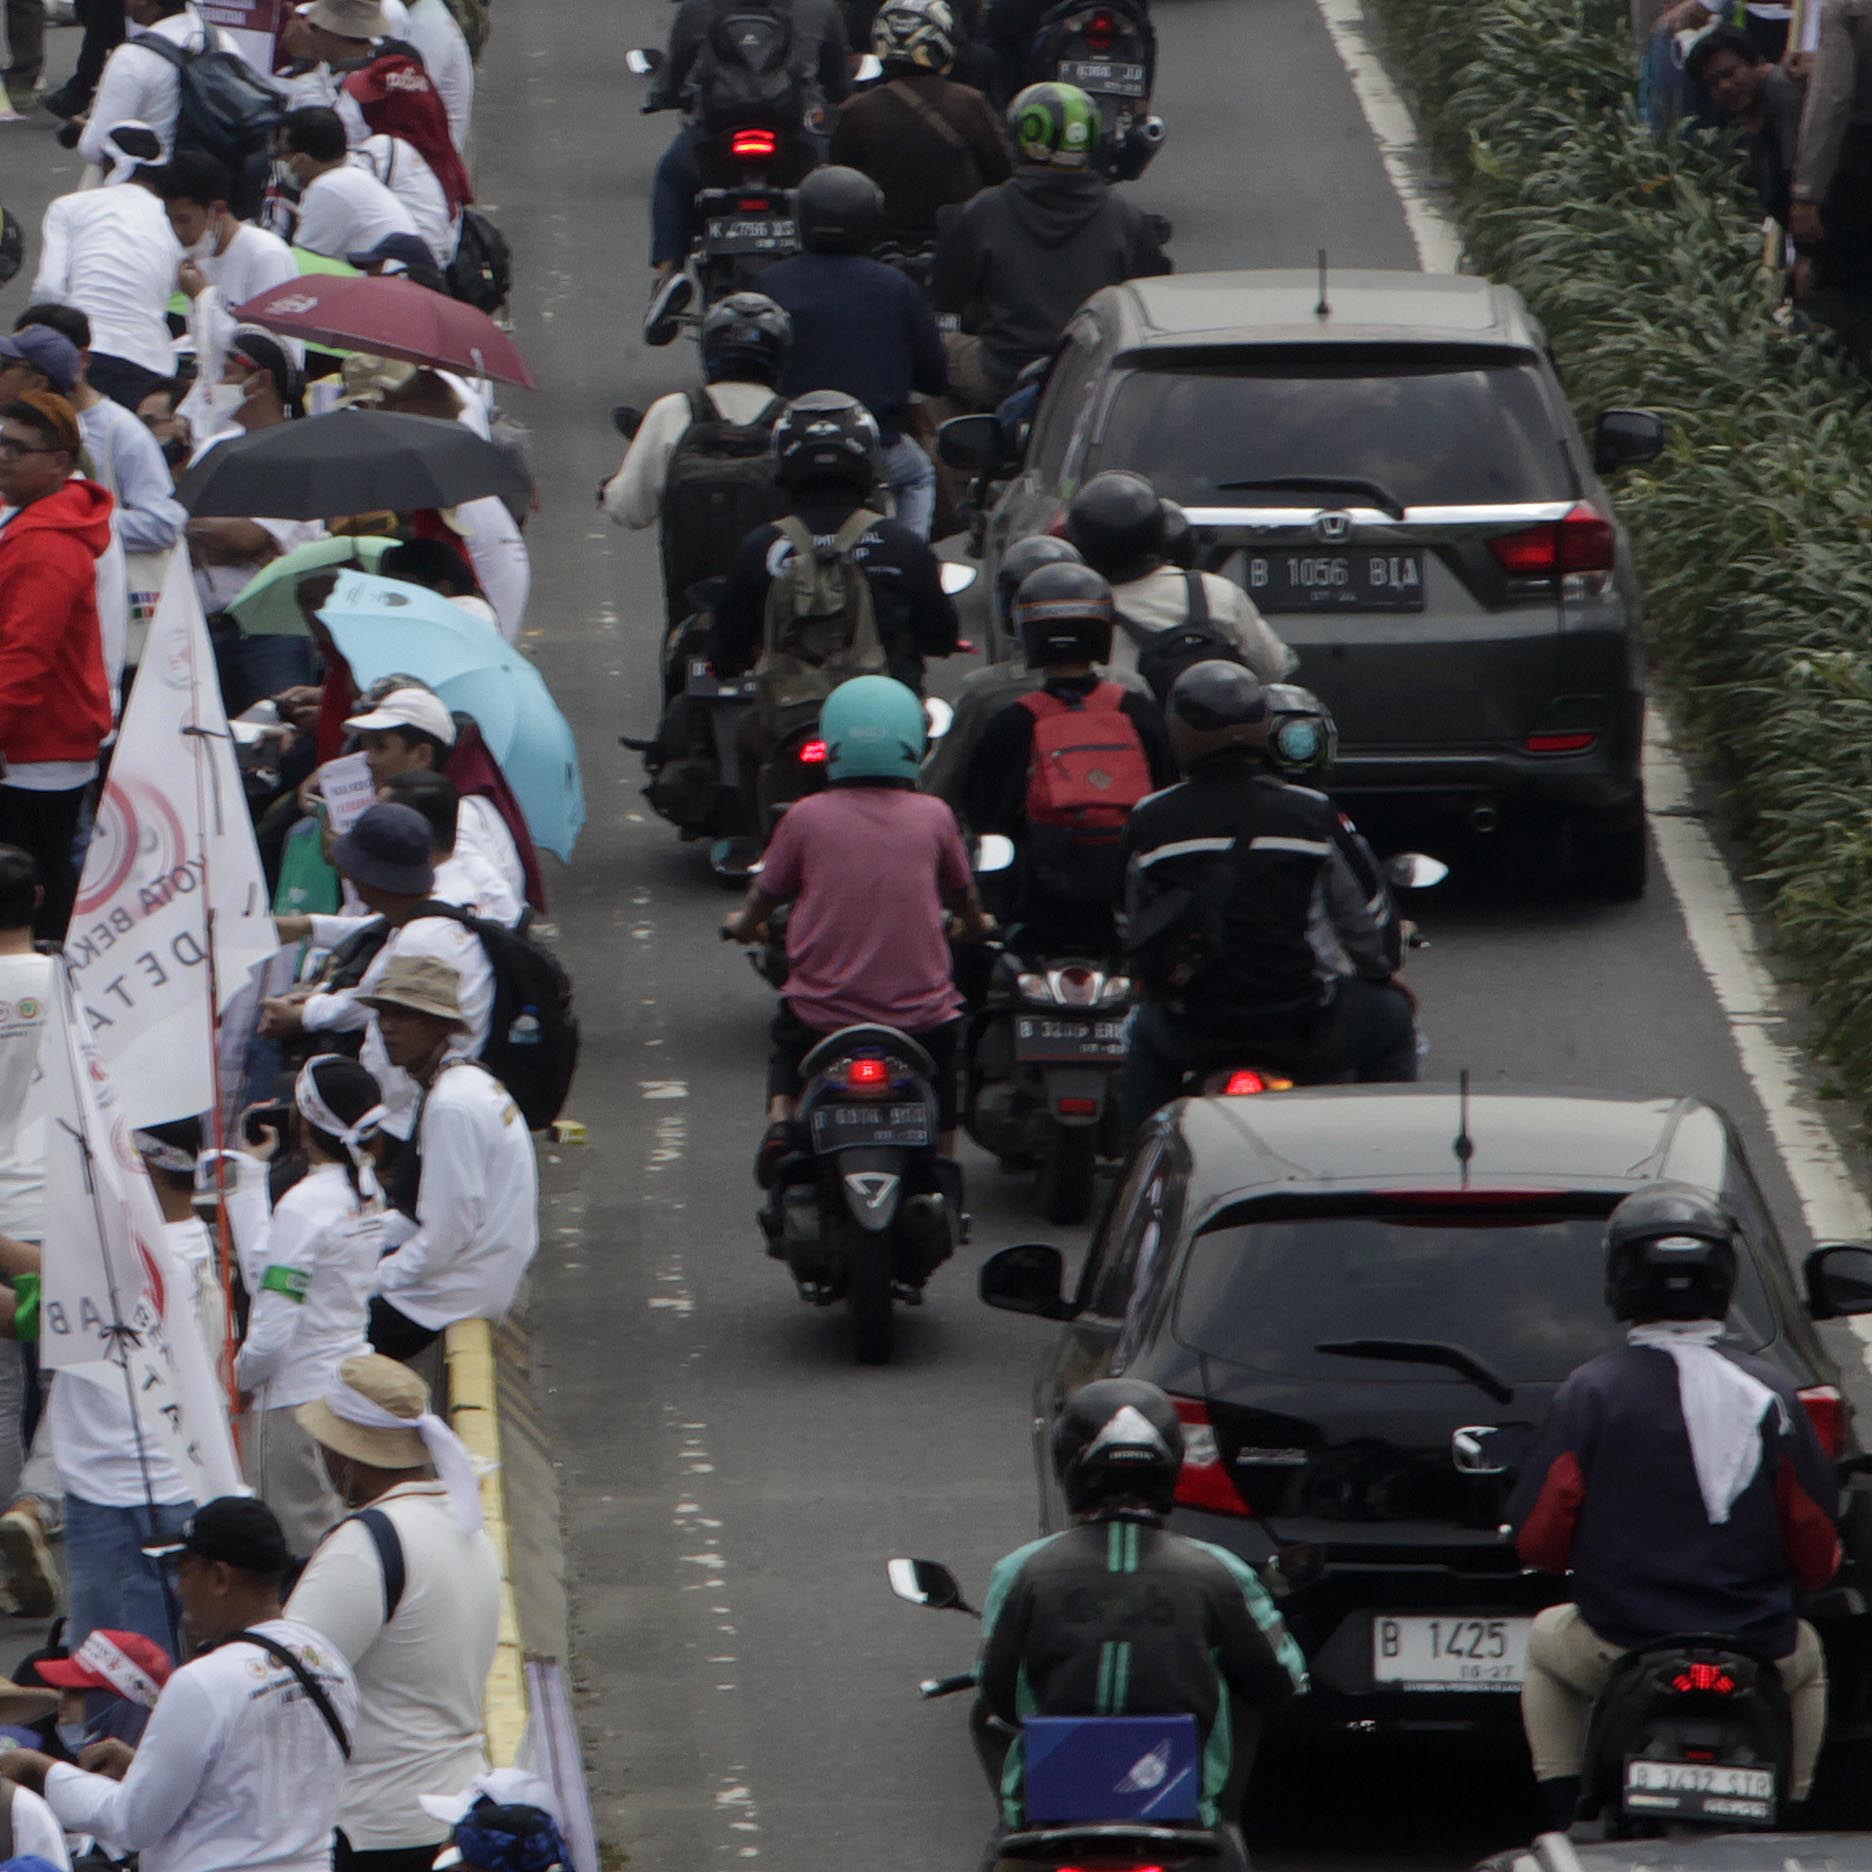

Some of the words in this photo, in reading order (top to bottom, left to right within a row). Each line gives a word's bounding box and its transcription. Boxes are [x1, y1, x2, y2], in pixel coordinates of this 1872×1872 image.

[1250, 556, 1269, 588] B
[1287, 554, 1349, 585] 1056
[1380, 1619, 1402, 1659] B
[1428, 1617, 1506, 1660] 1425
